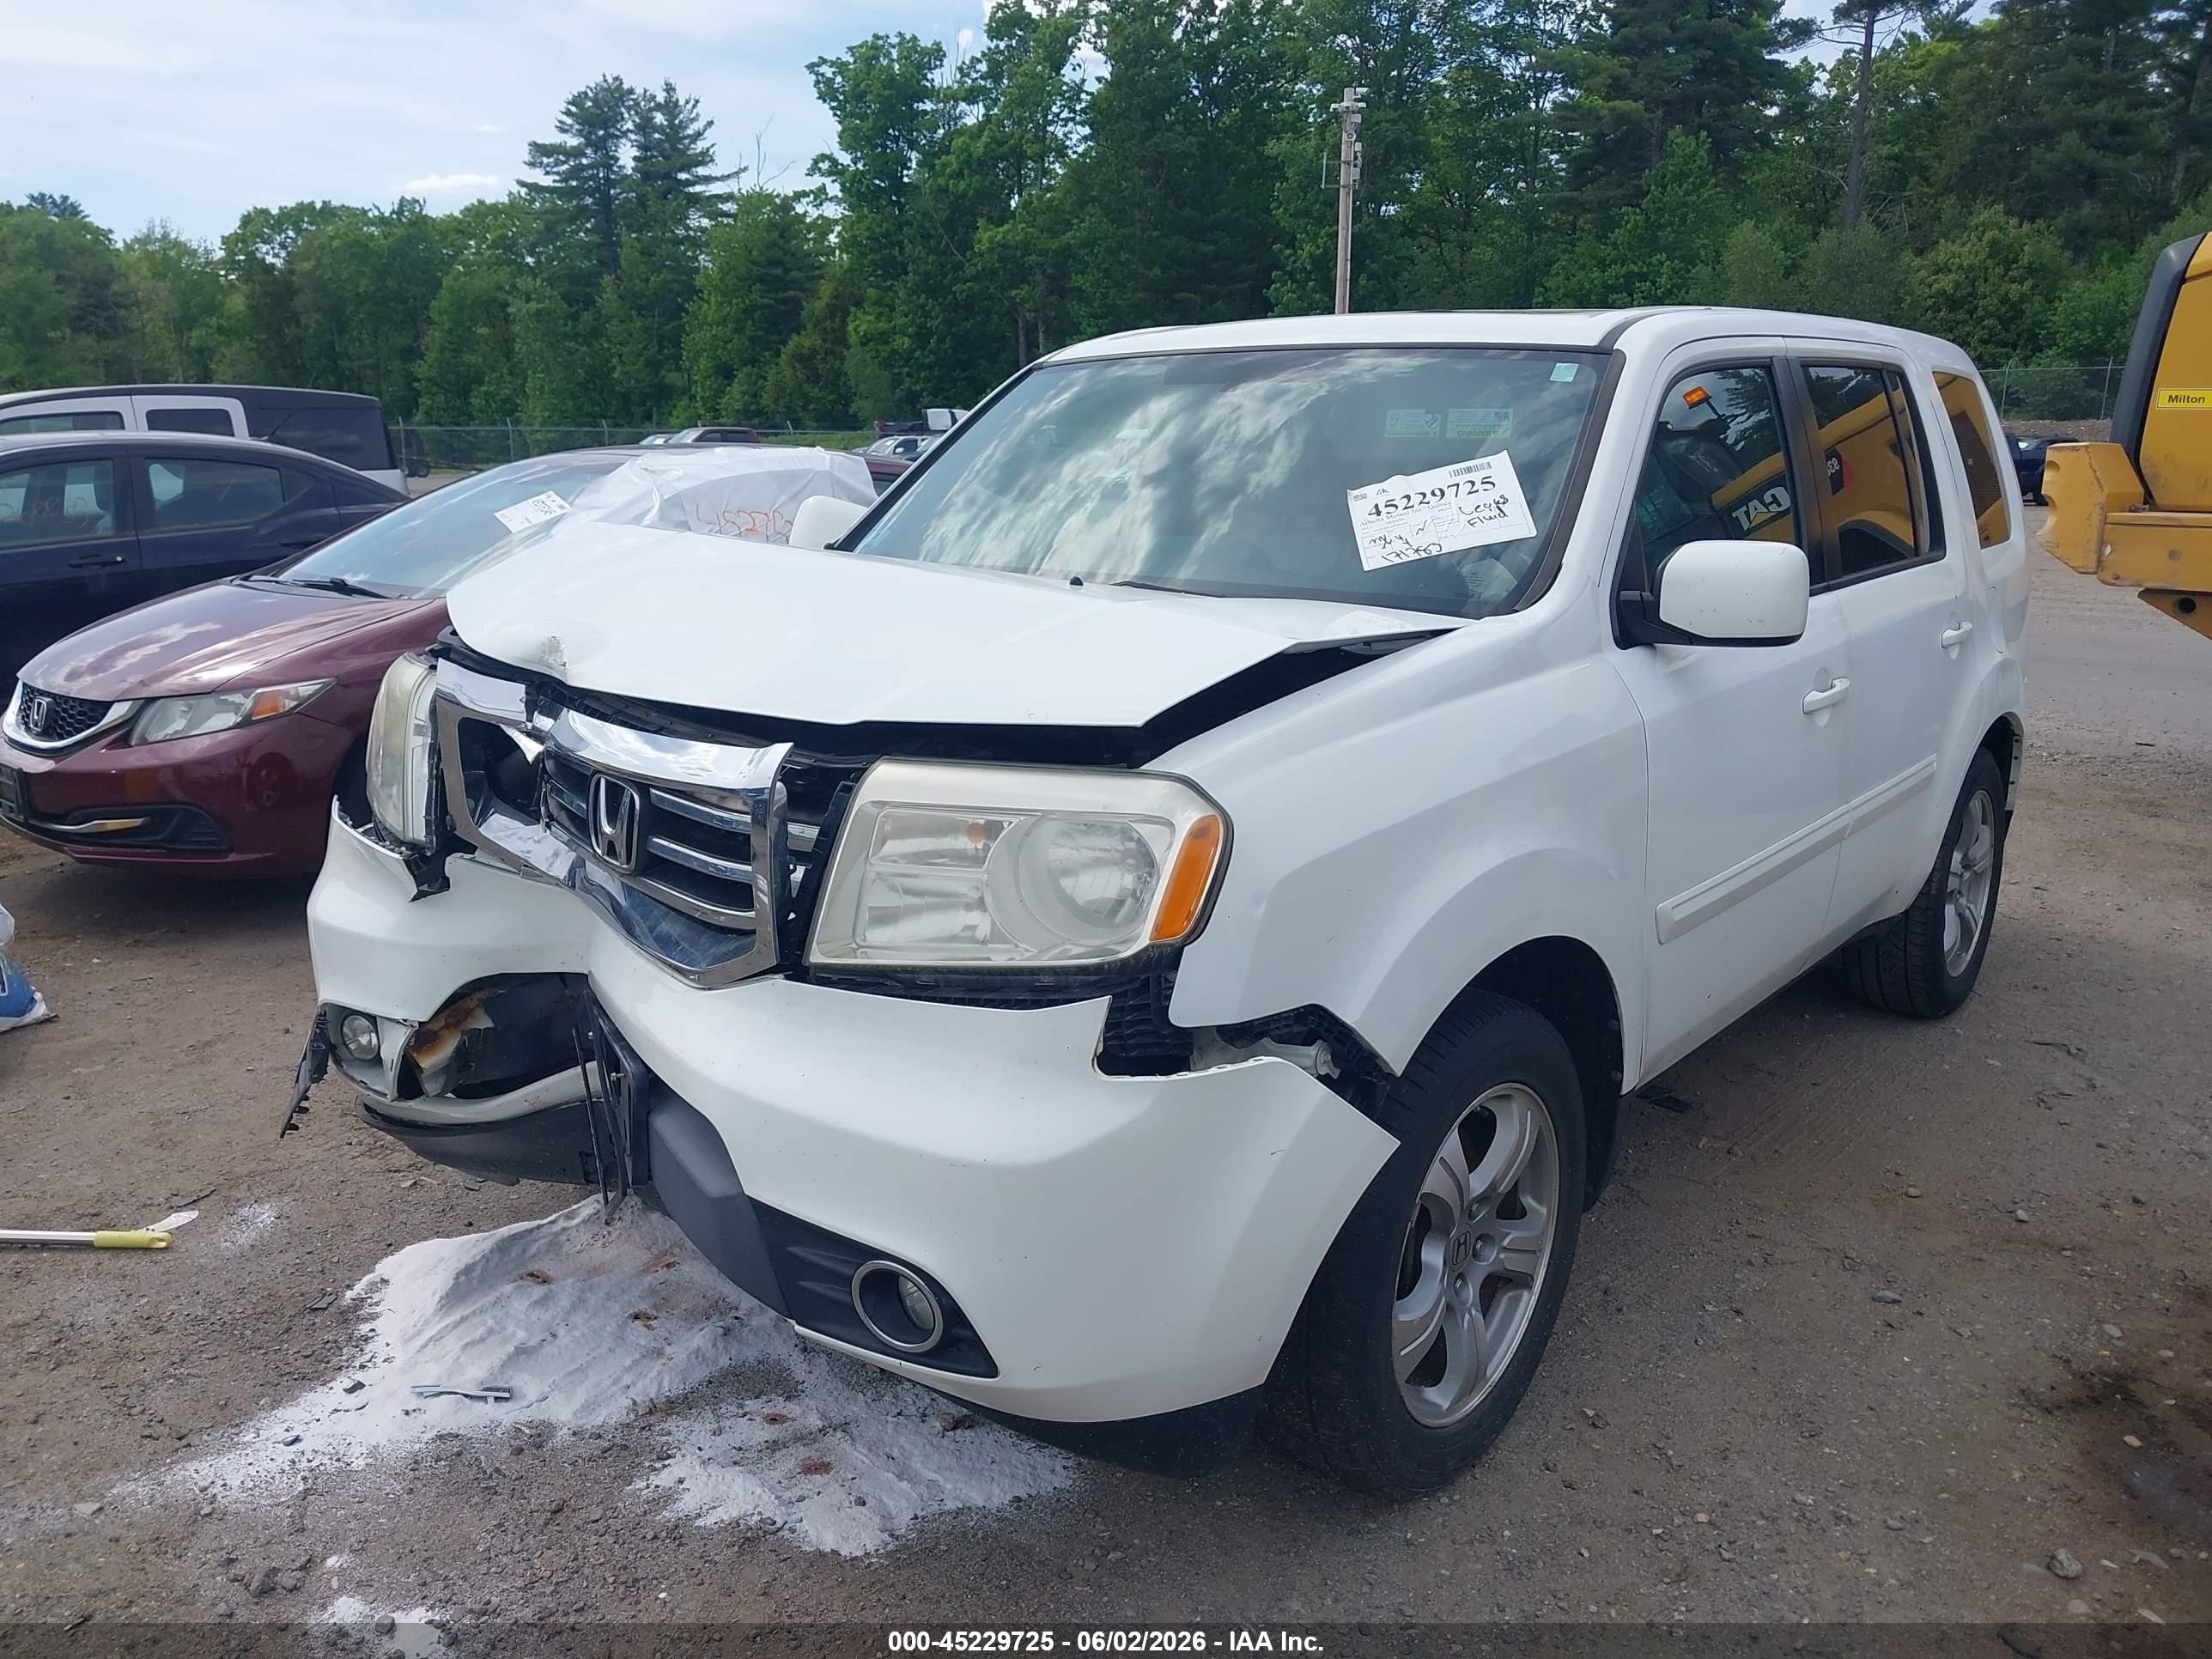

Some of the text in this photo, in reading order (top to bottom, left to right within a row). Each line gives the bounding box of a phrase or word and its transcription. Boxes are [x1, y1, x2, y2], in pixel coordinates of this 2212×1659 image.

[2168, 394, 2206, 404] Milton
[1368, 475, 1496, 517] 45229725
[1467, 505, 1510, 528] Fluid
